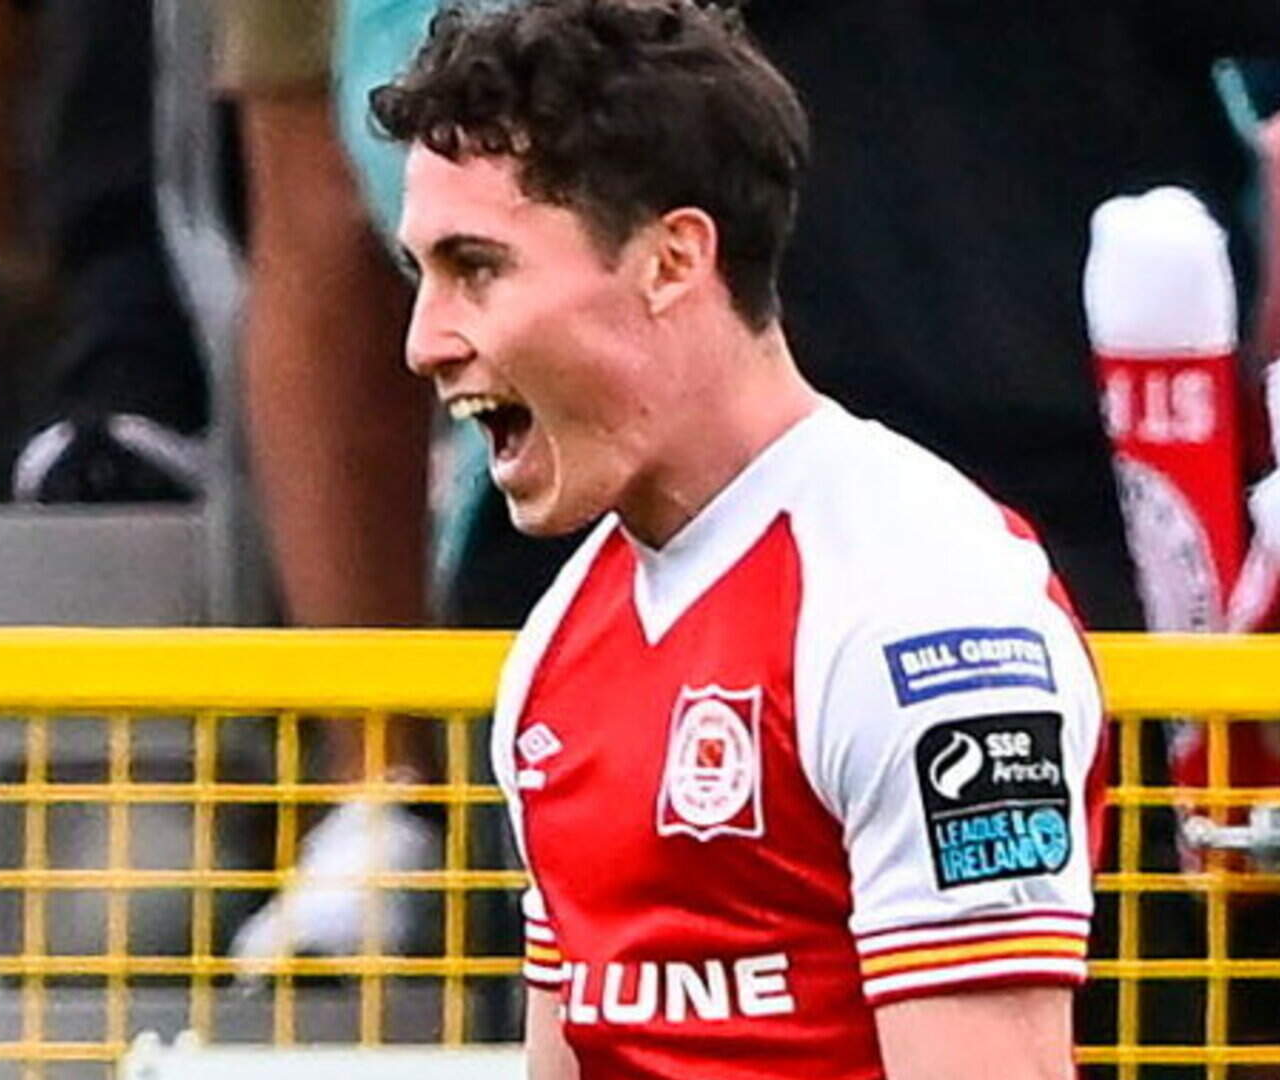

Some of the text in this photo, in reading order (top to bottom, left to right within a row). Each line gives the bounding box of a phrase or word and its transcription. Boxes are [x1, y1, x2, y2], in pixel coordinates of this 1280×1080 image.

[900, 643, 957, 675] BILL
[986, 731, 1032, 757] sse
[935, 811, 1009, 849] LEAGUE
[940, 836, 1038, 881] IRELAND
[561, 951, 797, 1025] LUNE
